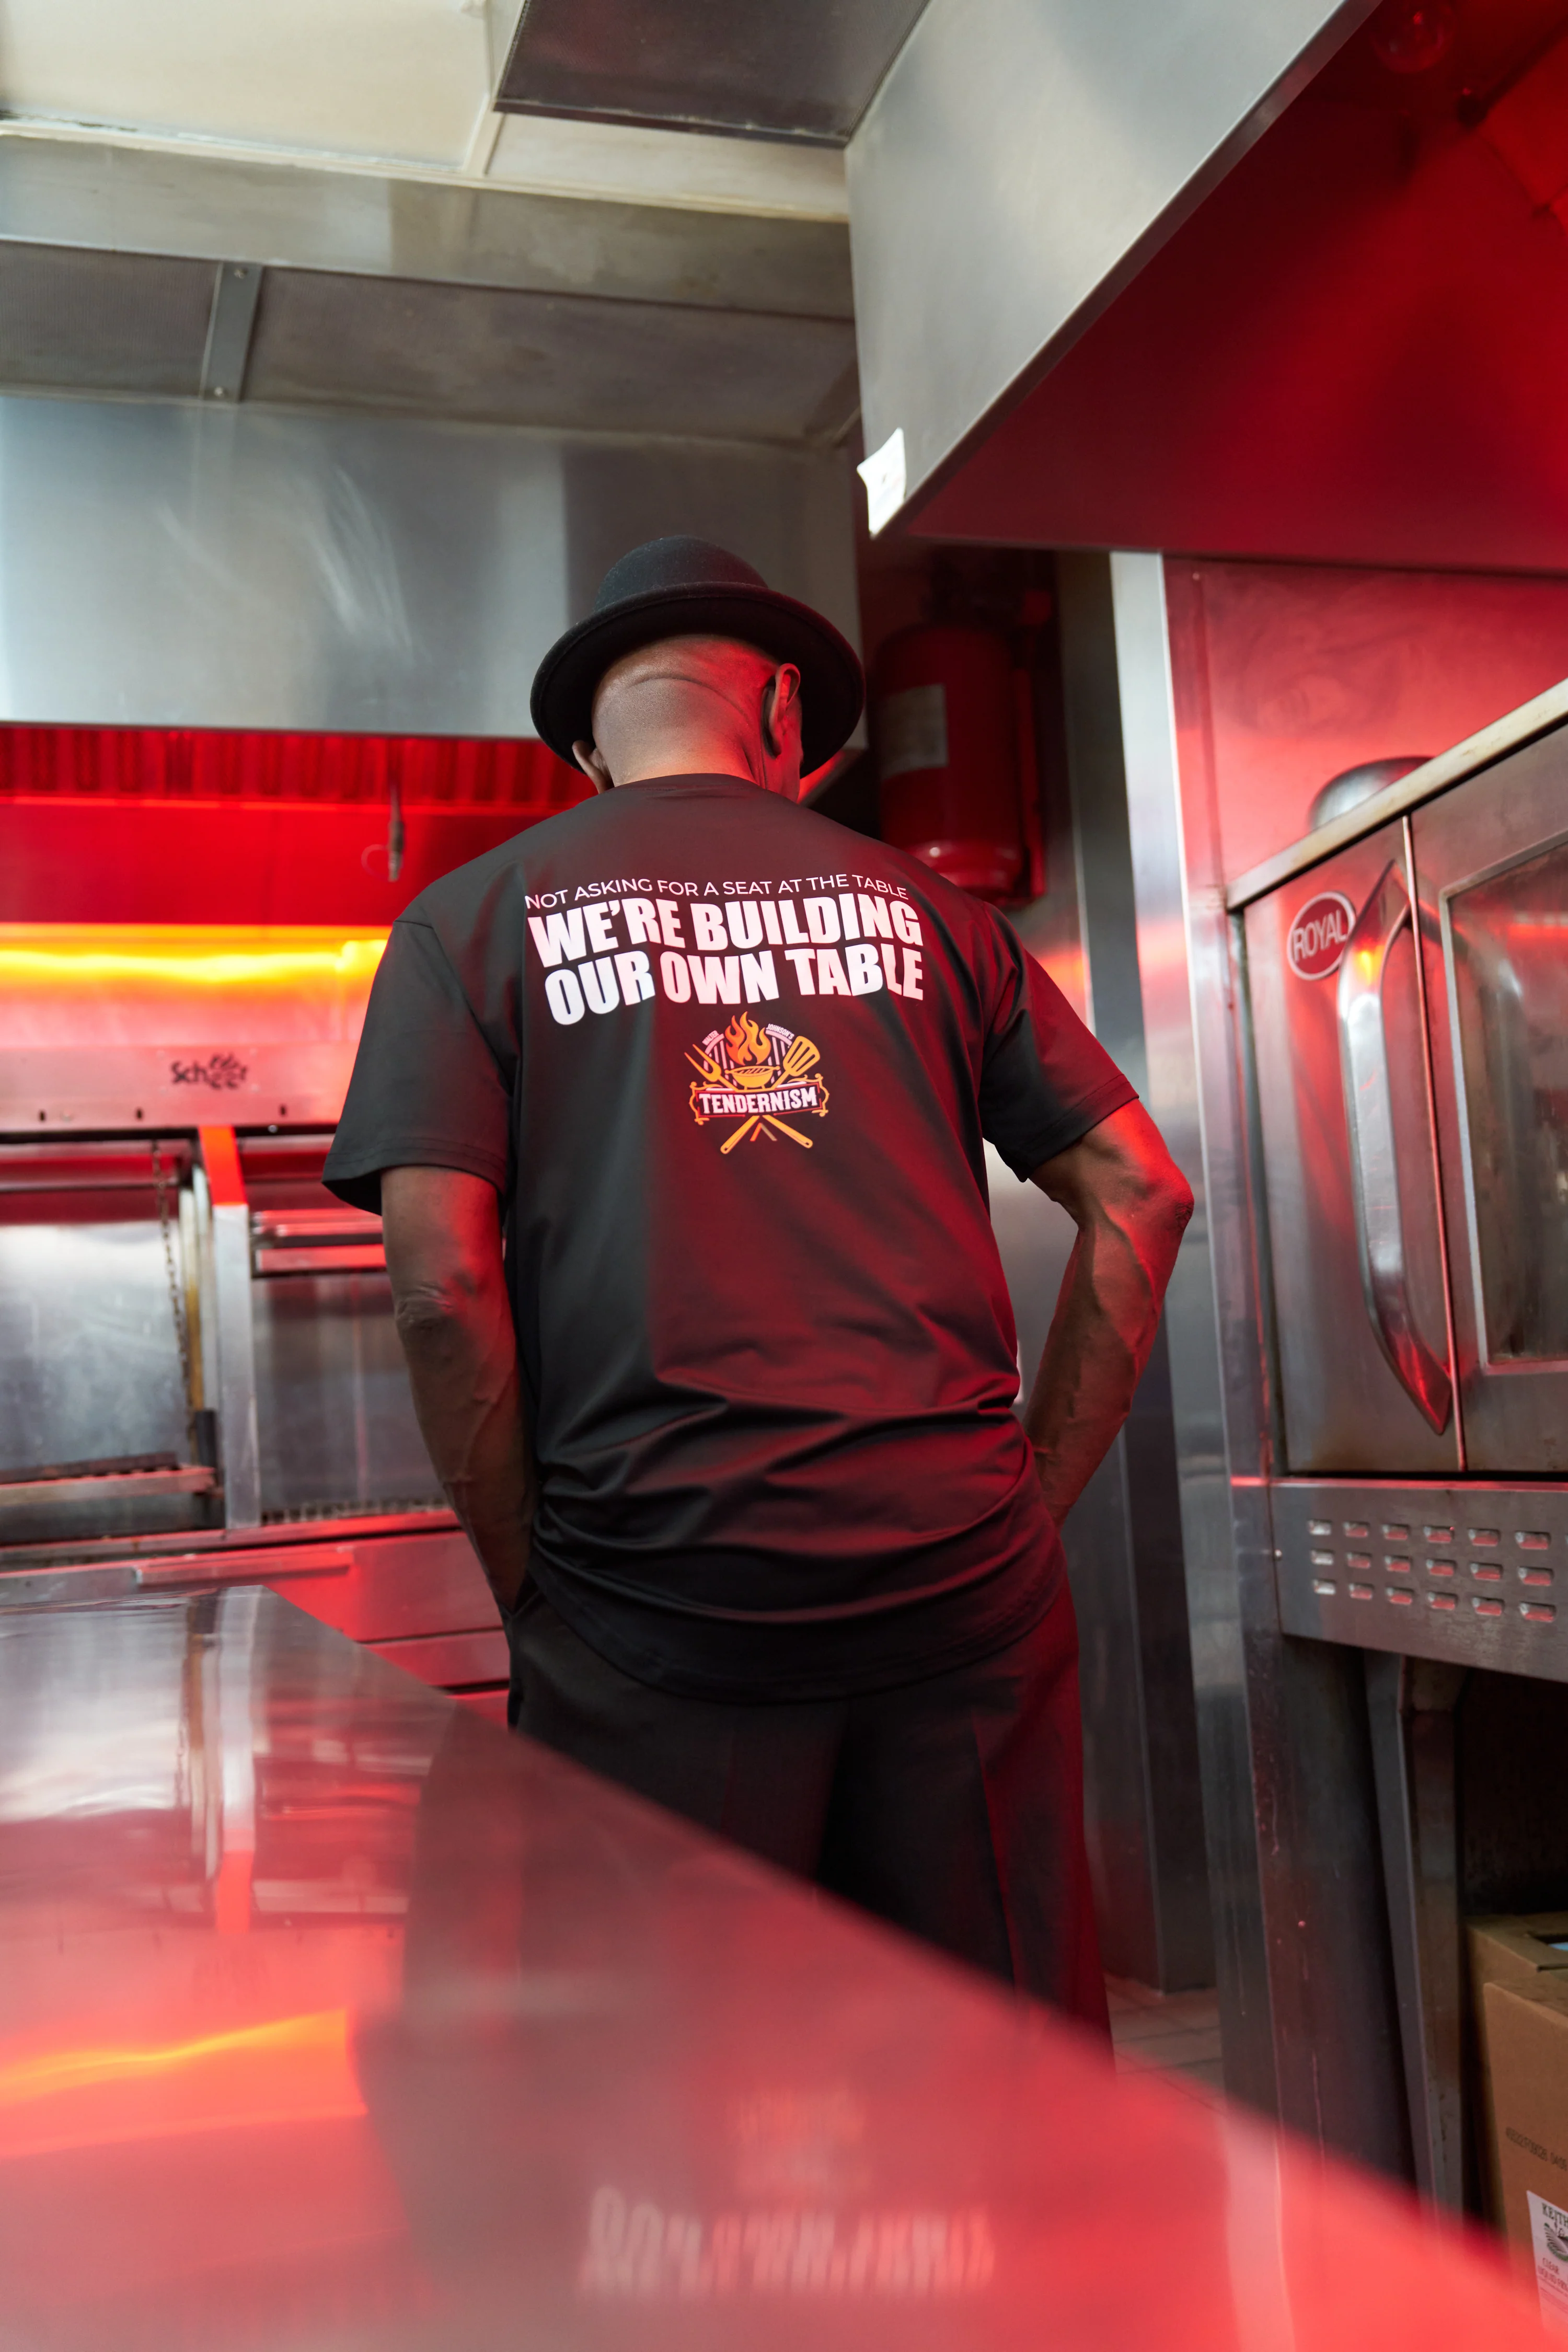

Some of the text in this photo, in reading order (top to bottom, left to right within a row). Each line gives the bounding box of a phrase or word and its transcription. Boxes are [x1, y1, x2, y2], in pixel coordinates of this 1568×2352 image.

[524, 873, 909, 909] NOT ASKING FOR A SEAT AT THE TABLE
[527, 893, 924, 968] WE'RE BUILDING
[1293, 909, 1347, 964] ROYAL
[545, 943, 924, 1025] OUR OWN TABLE
[766, 1023, 795, 1040] JOHNSON'S
[699, 1086, 817, 1114] TENDERNISM
